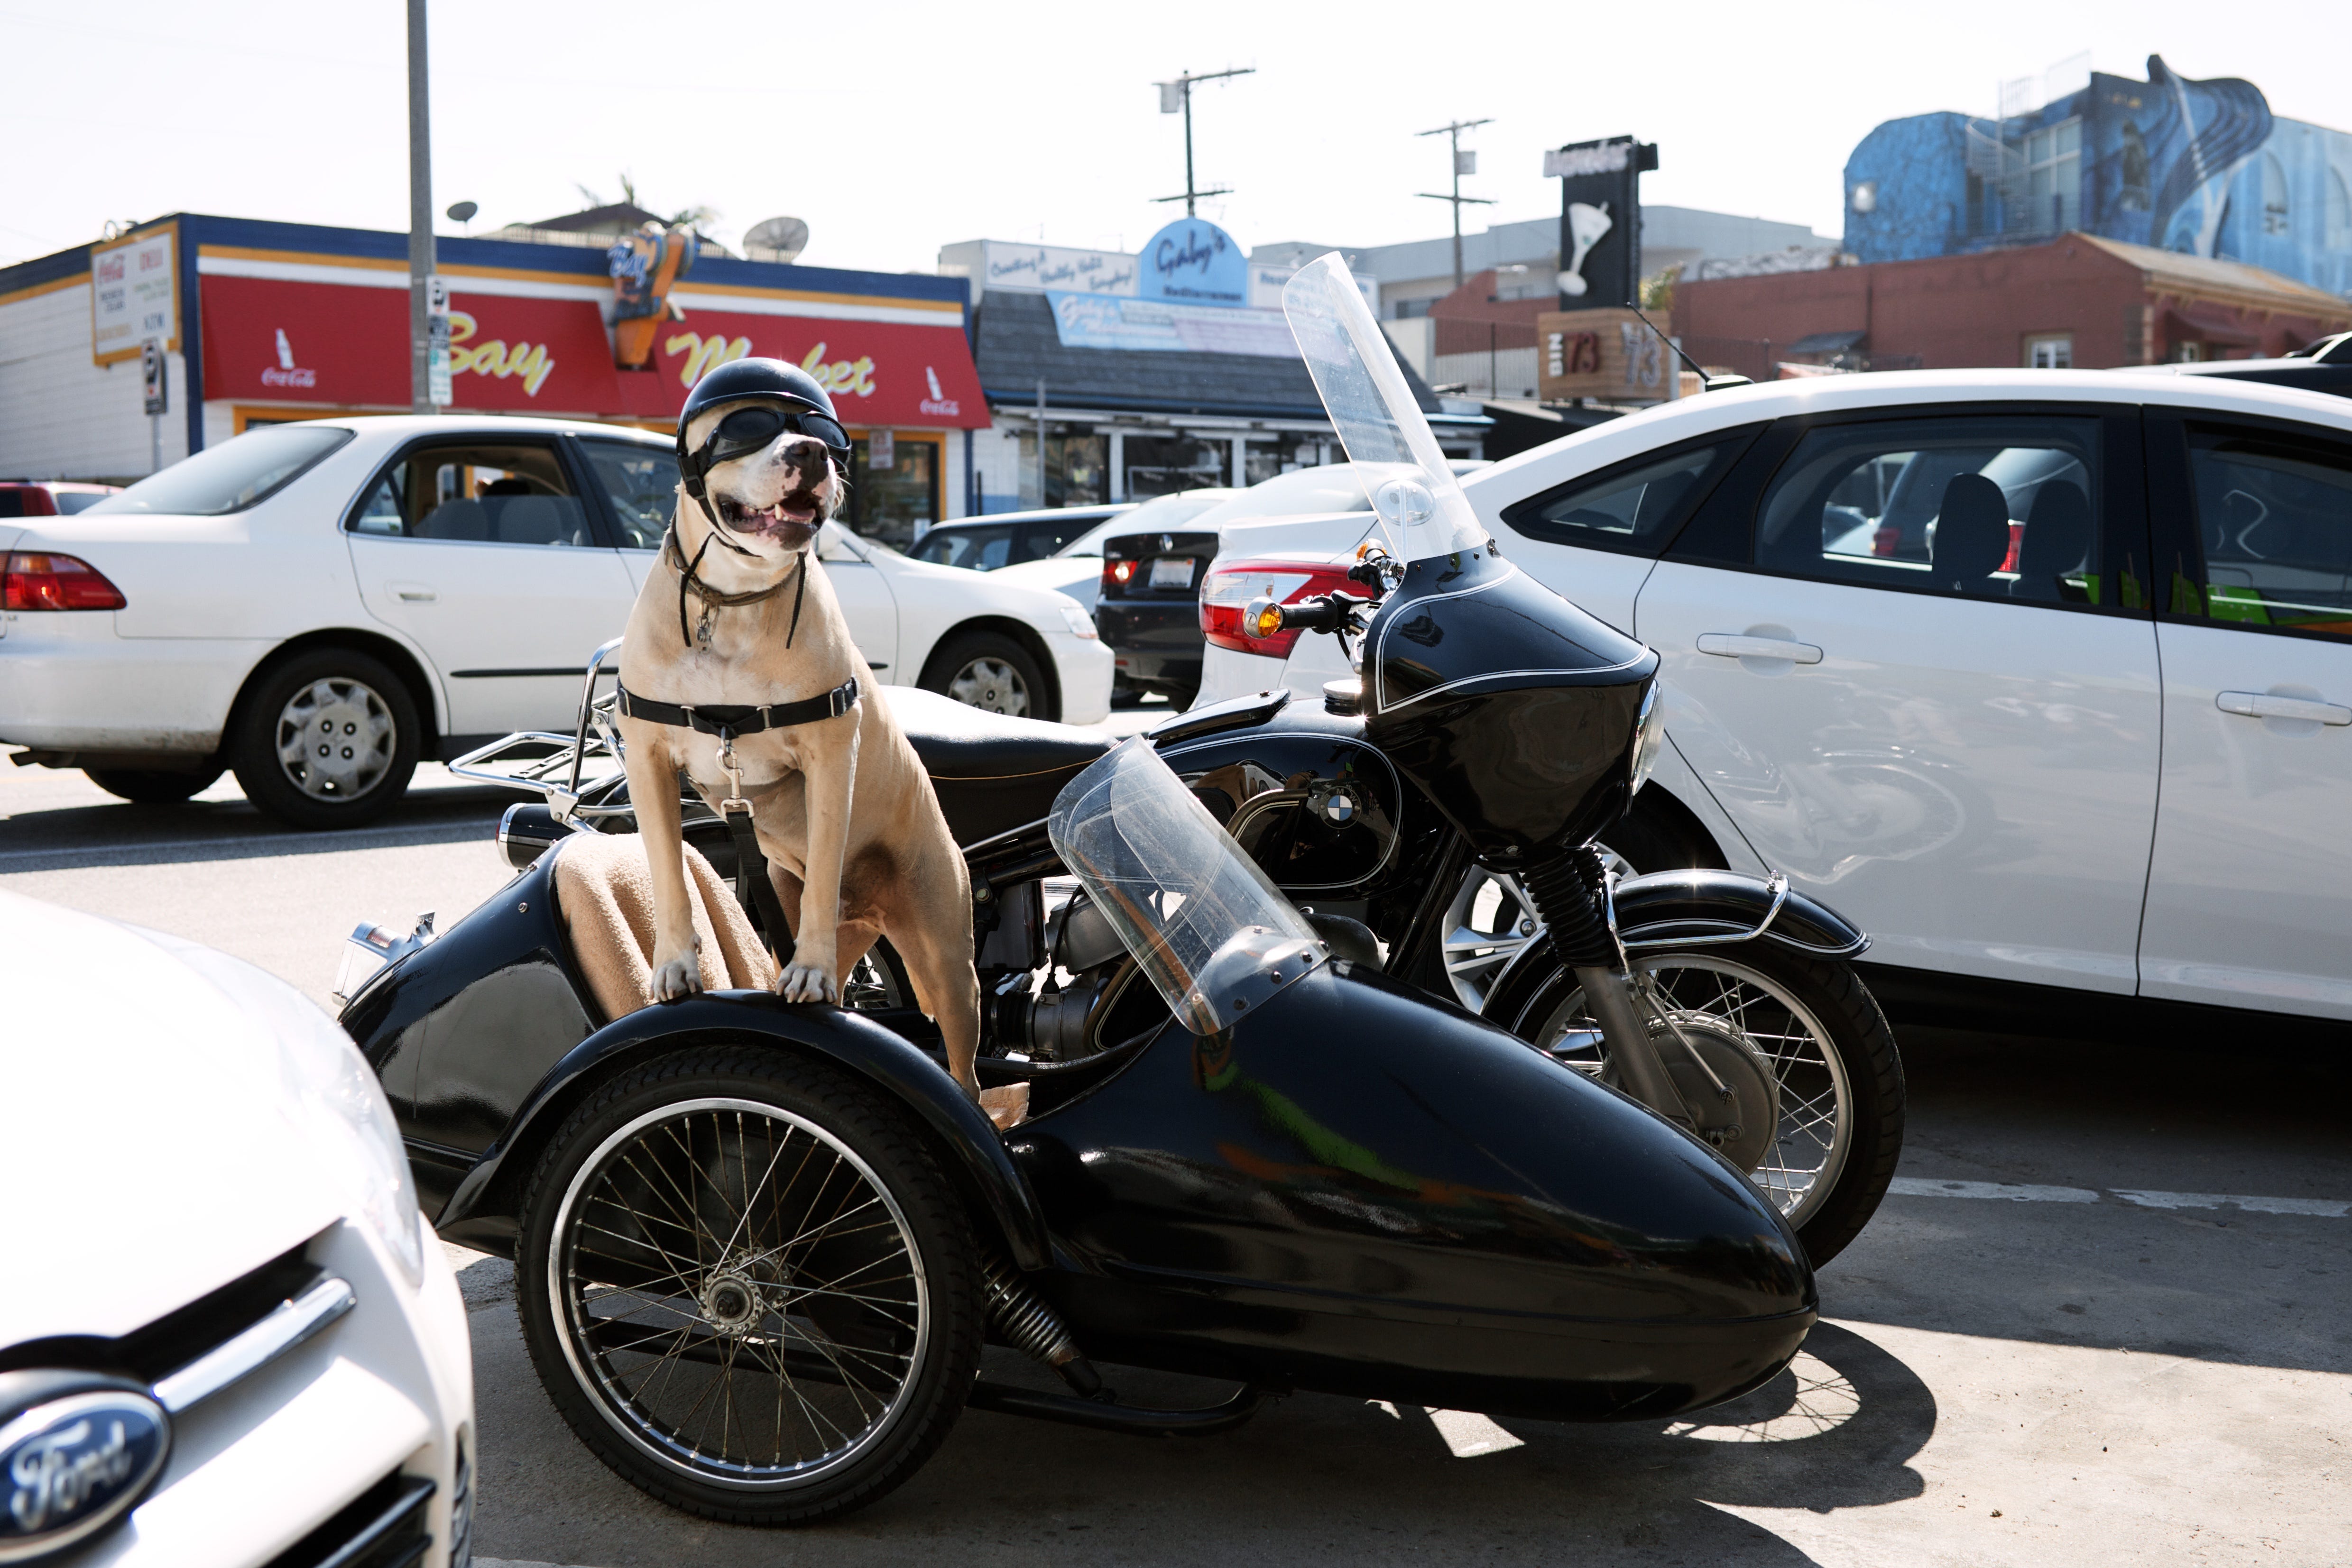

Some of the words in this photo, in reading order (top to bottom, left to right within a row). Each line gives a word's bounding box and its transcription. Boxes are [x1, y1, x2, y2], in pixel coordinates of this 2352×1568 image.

[1155, 227, 1226, 278] Gaby's
[665, 331, 876, 397] Mket
[1548, 333, 1564, 378] BIN
[1563, 332, 1597, 375] 73
[1324, 788, 1358, 802] BMW
[10, 1420, 133, 1532] Ford
